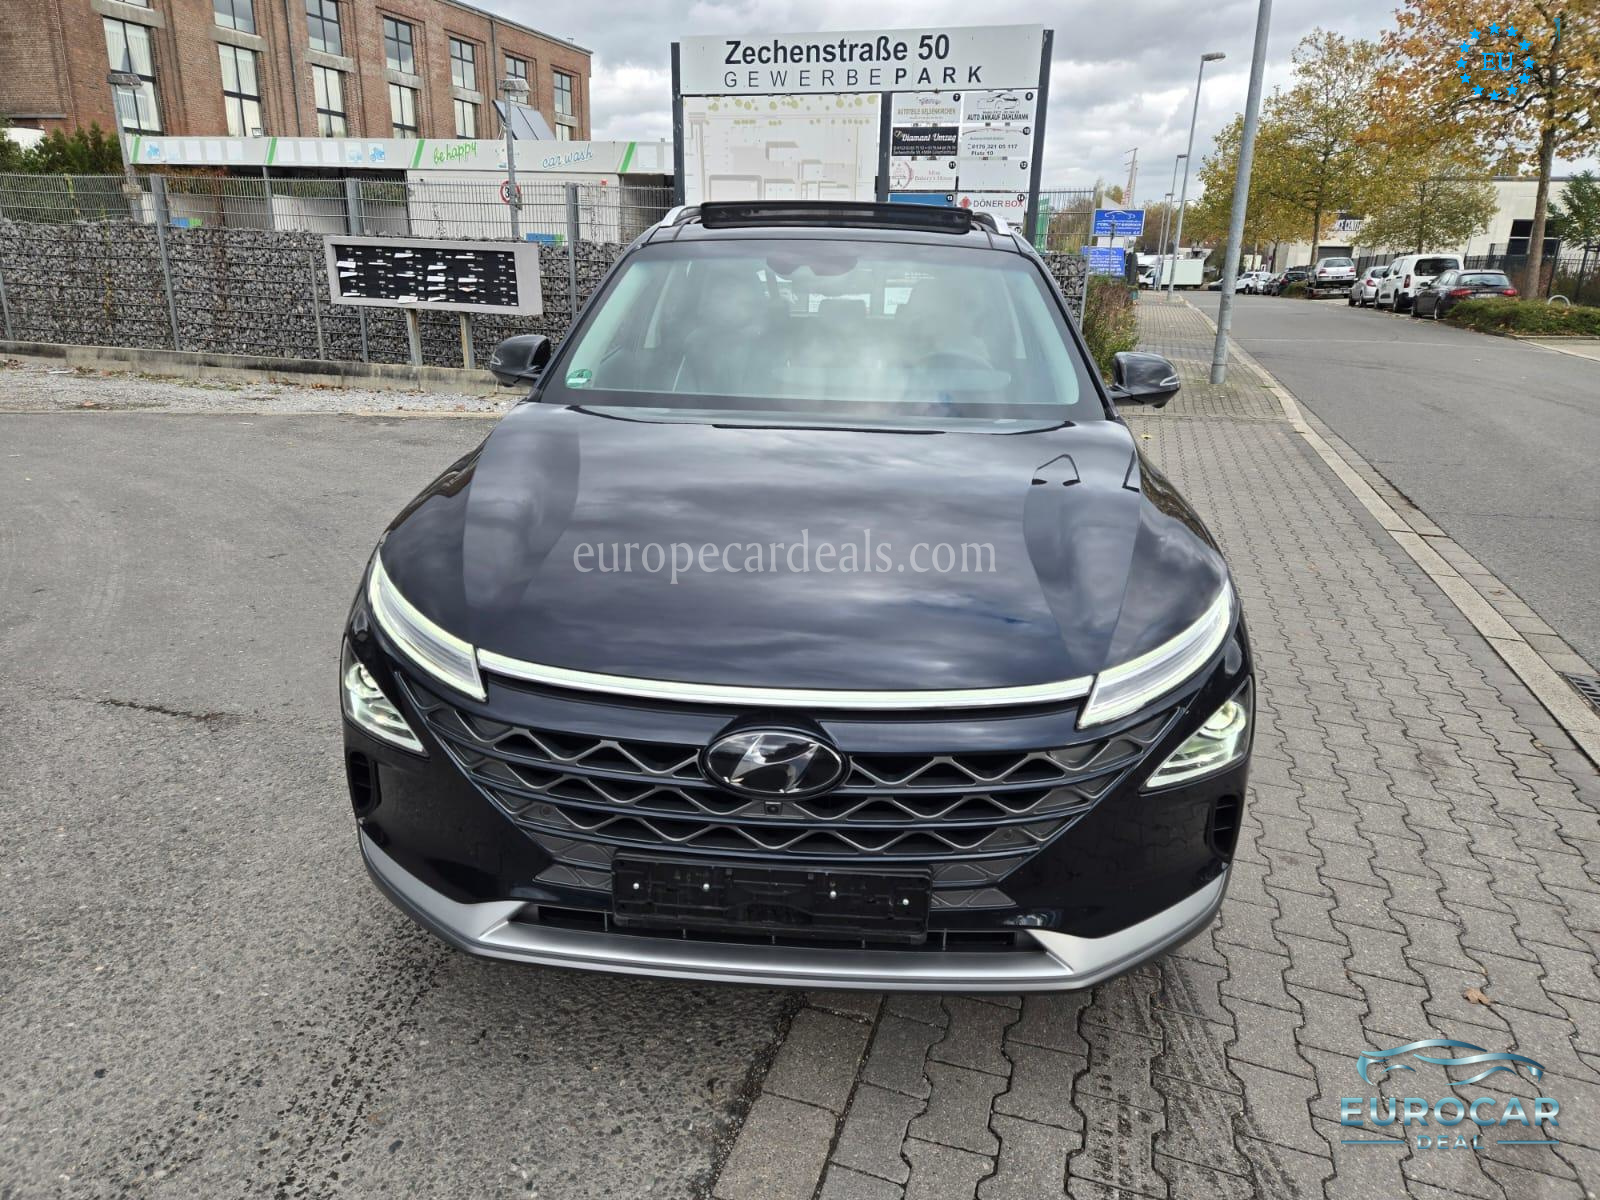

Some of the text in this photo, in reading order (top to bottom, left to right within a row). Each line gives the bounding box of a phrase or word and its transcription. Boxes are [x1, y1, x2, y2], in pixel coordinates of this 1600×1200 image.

[725, 34, 950, 65] Zechenstraße 50
[724, 65, 983, 87] GEWERBEPARK
[902, 132, 957, 143] Diamant Umzug
[445, 142, 477, 165] happy
[542, 144, 593, 168] car wash
[973, 199, 1003, 207] DÖNER
